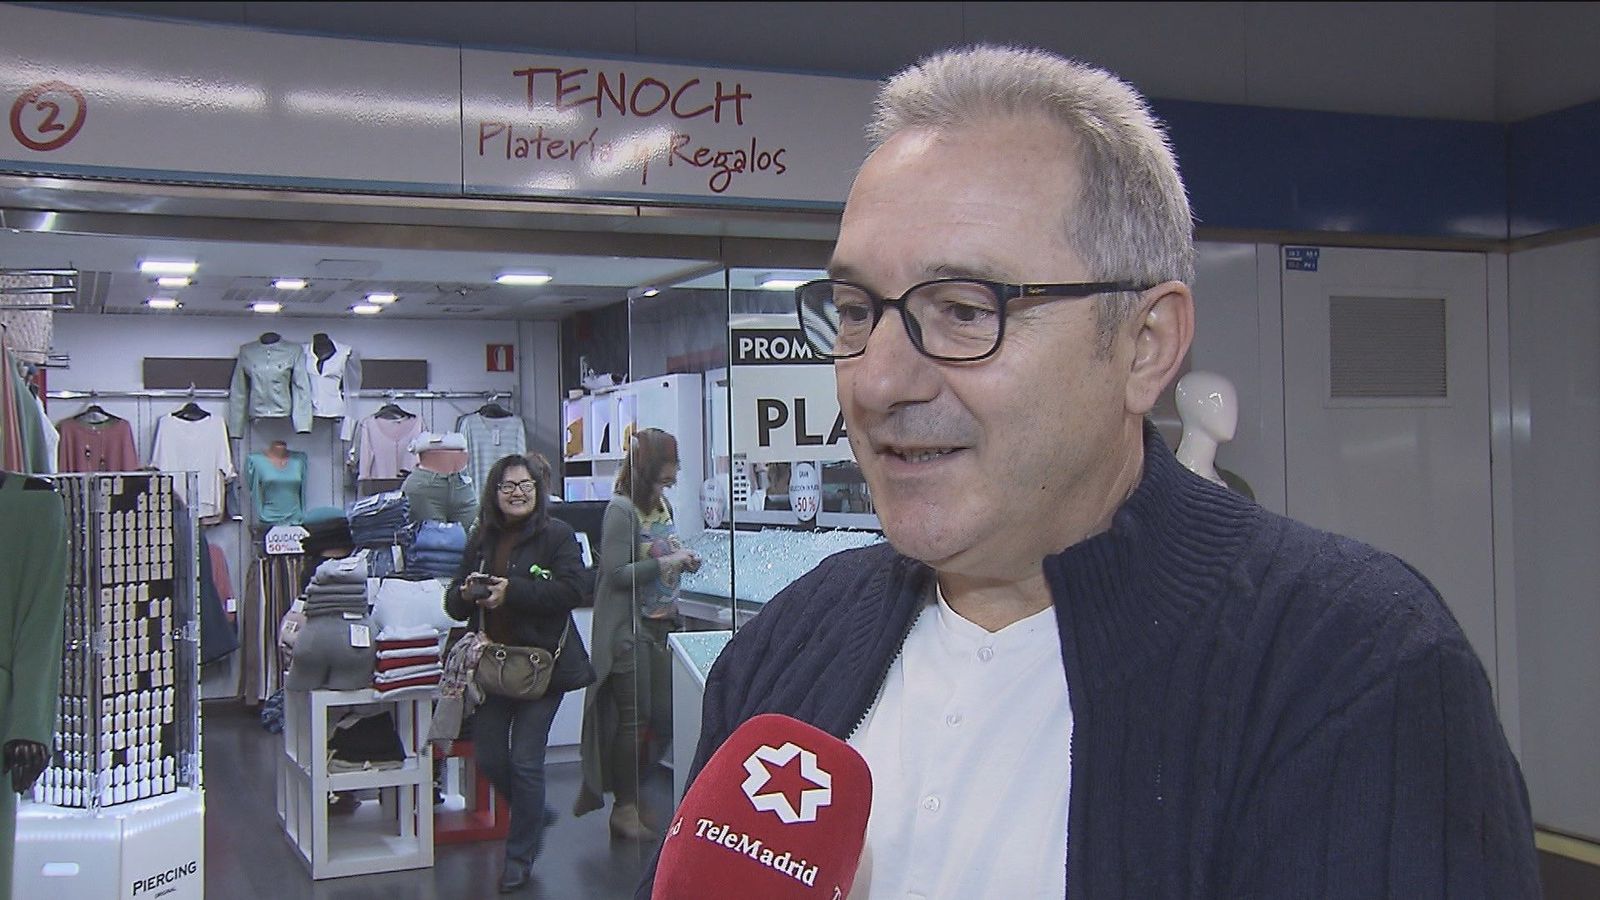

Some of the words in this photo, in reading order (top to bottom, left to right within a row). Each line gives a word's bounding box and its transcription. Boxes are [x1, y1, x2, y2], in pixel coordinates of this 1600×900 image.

[35, 101, 65, 133] 2
[513, 68, 752, 125] TENOCH
[668, 132, 787, 193] Regalos
[739, 336, 822, 360] PROM
[695, 818, 819, 887] TeleMadrid
[132, 861, 197, 896] PIERCING
